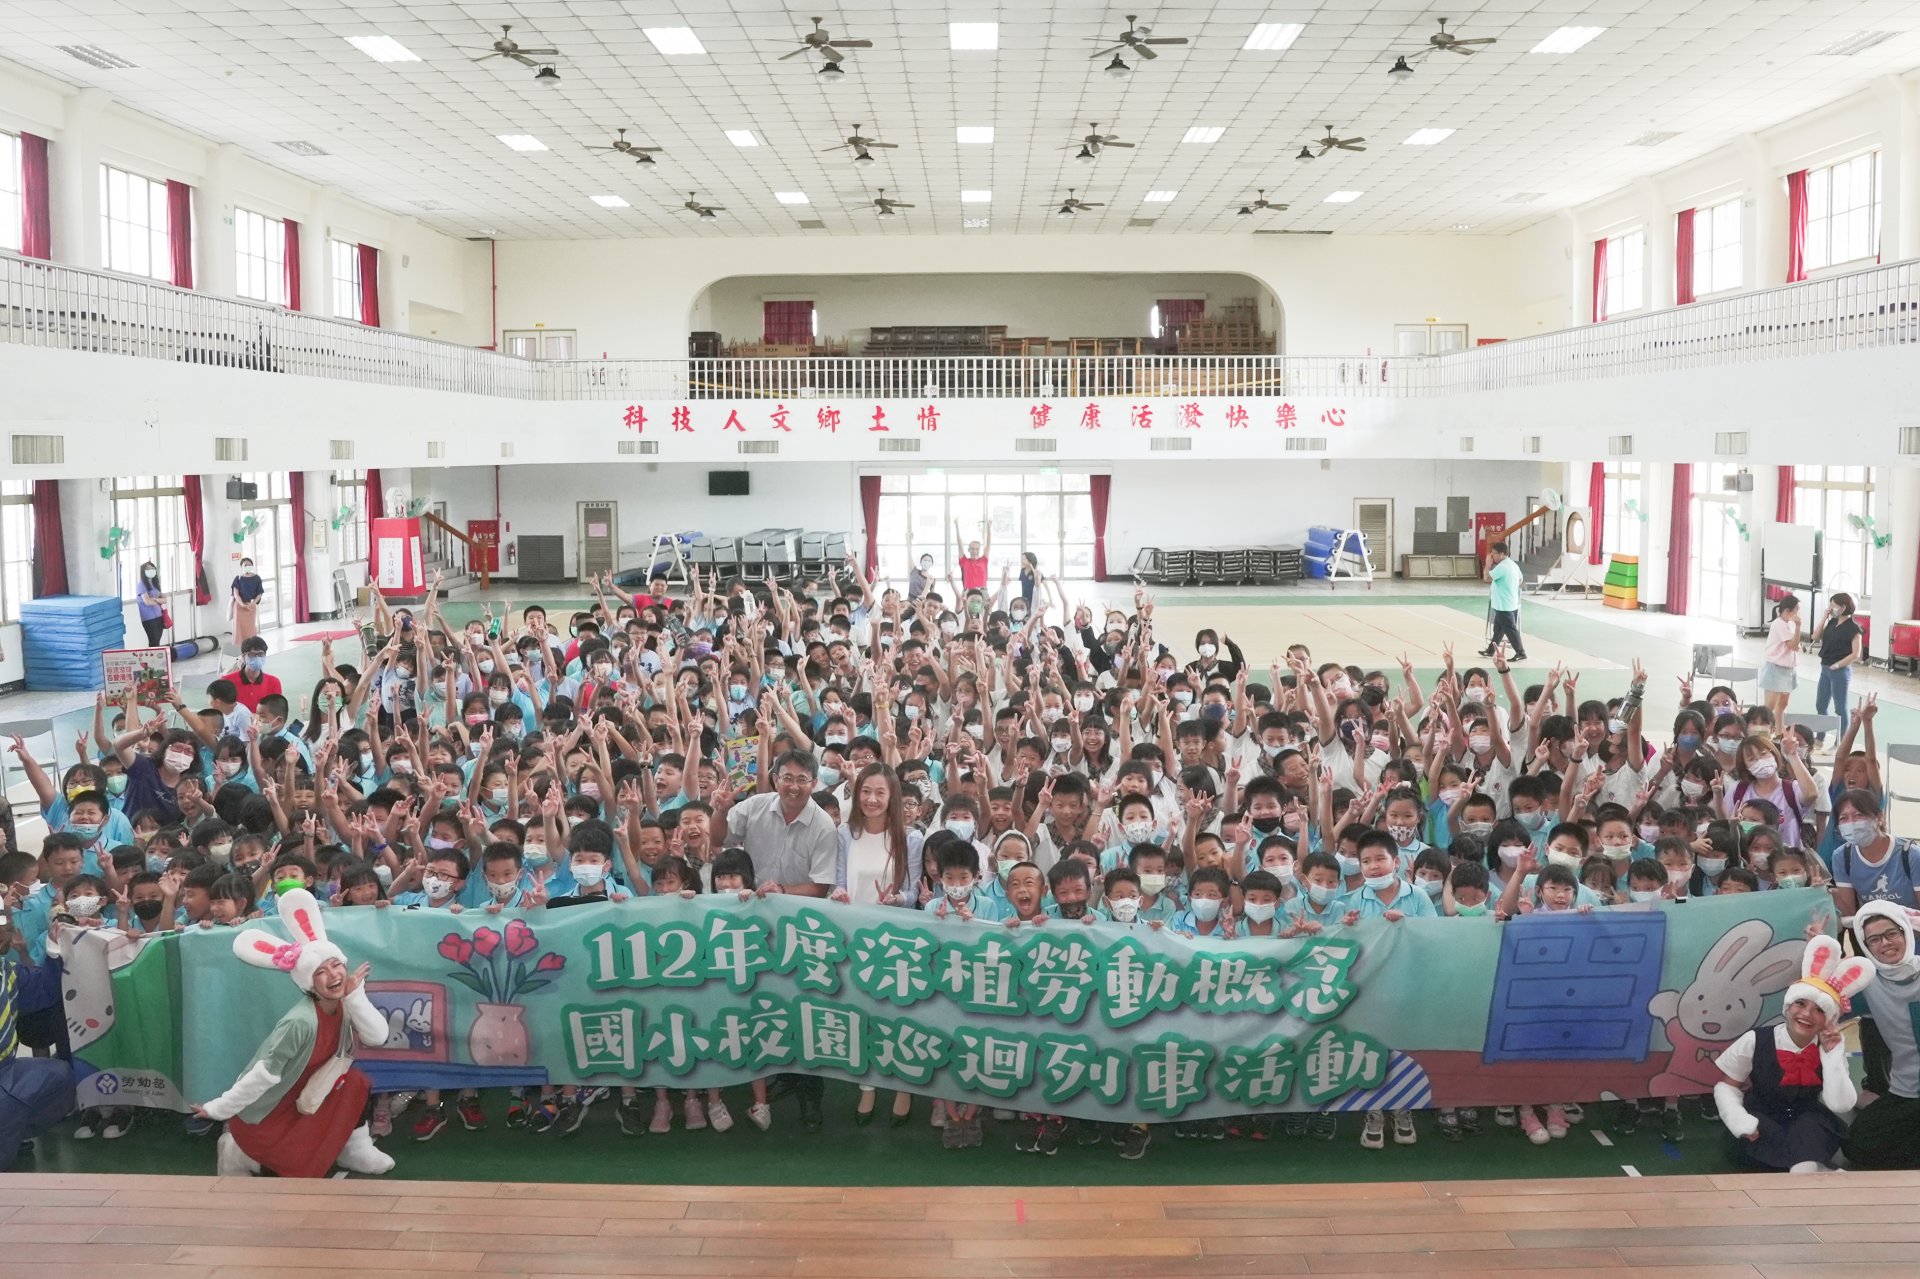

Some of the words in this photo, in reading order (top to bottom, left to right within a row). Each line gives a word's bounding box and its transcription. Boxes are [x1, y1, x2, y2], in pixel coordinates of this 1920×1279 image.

[622, 402, 941, 432] 科技人文鄉土情
[1861, 893, 1902, 901] KANGOL
[591, 916, 1351, 1020] 112年度深植勞動概念
[568, 1000, 1380, 1109] 國小校園巡迴列車活動
[121, 1075, 166, 1089] 勞動部
